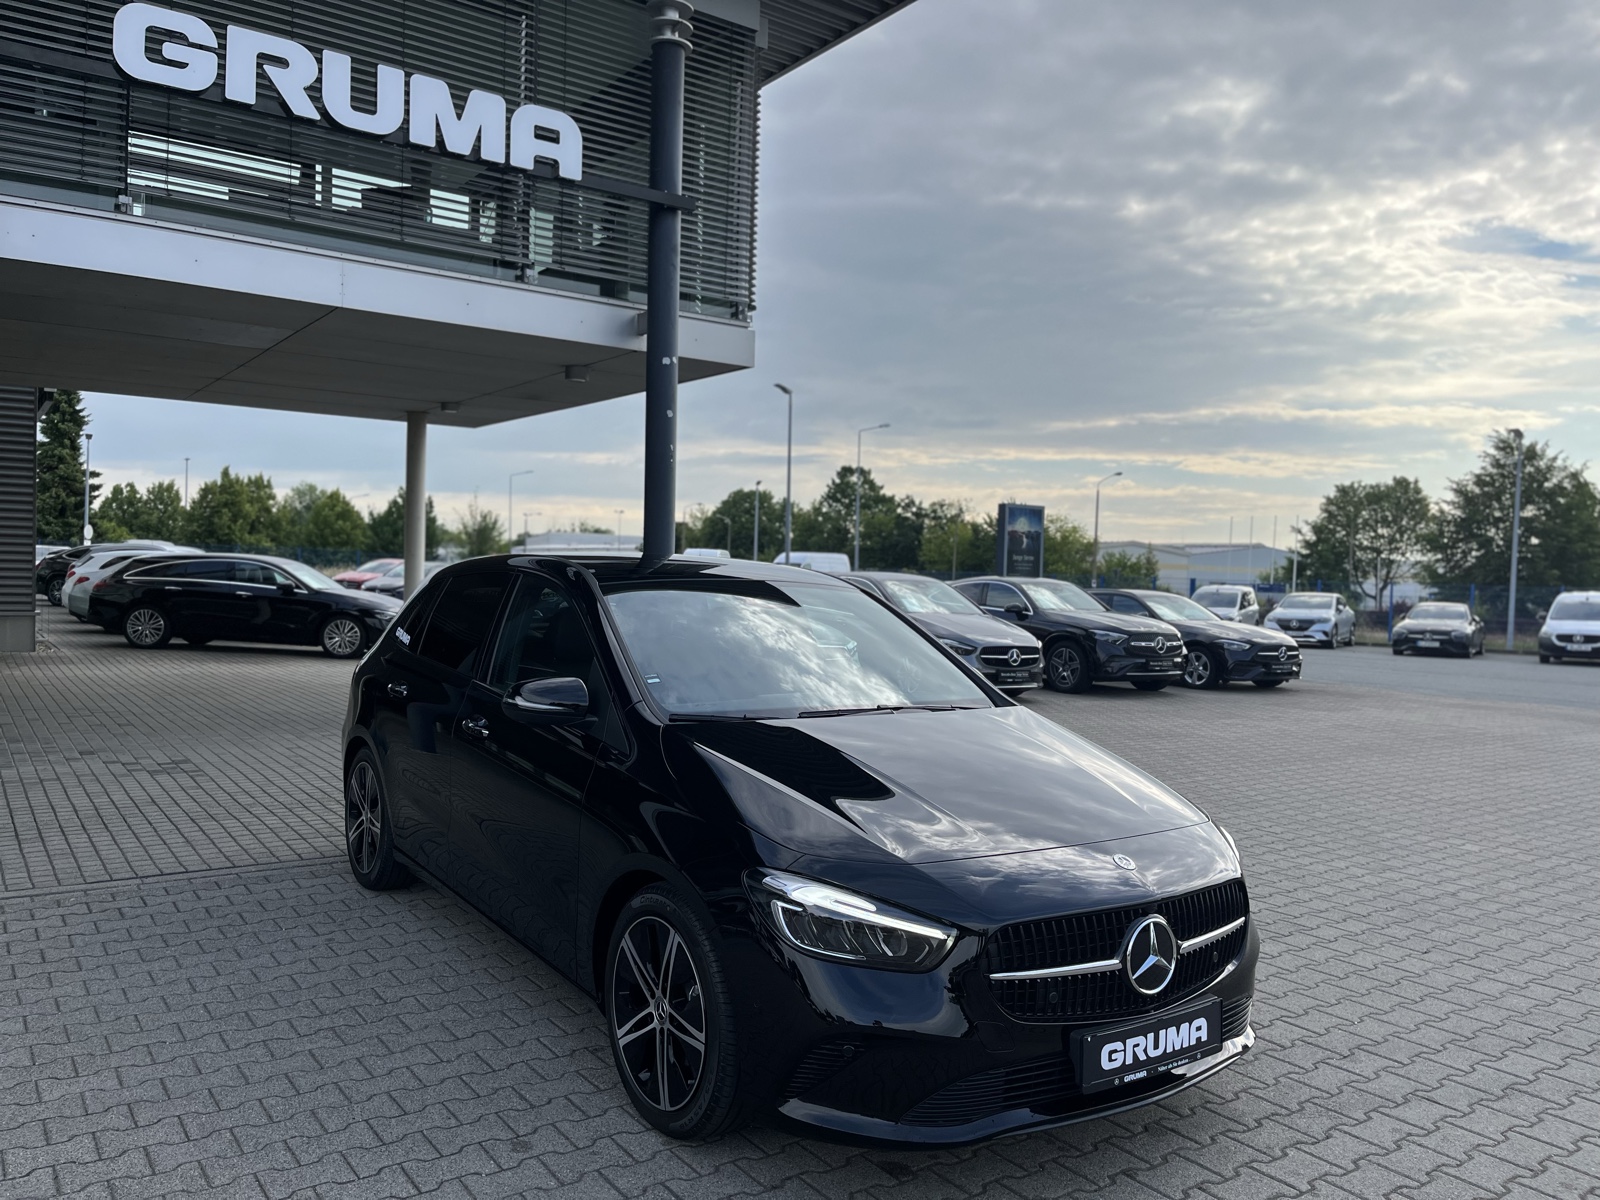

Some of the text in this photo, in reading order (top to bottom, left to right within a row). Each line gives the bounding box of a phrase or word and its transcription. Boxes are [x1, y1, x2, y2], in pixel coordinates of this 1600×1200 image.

[112, 2, 583, 182] GRUMA
[1101, 1017, 1208, 1071] GRUMA
[1123, 1070, 1147, 1083] GRUMA
